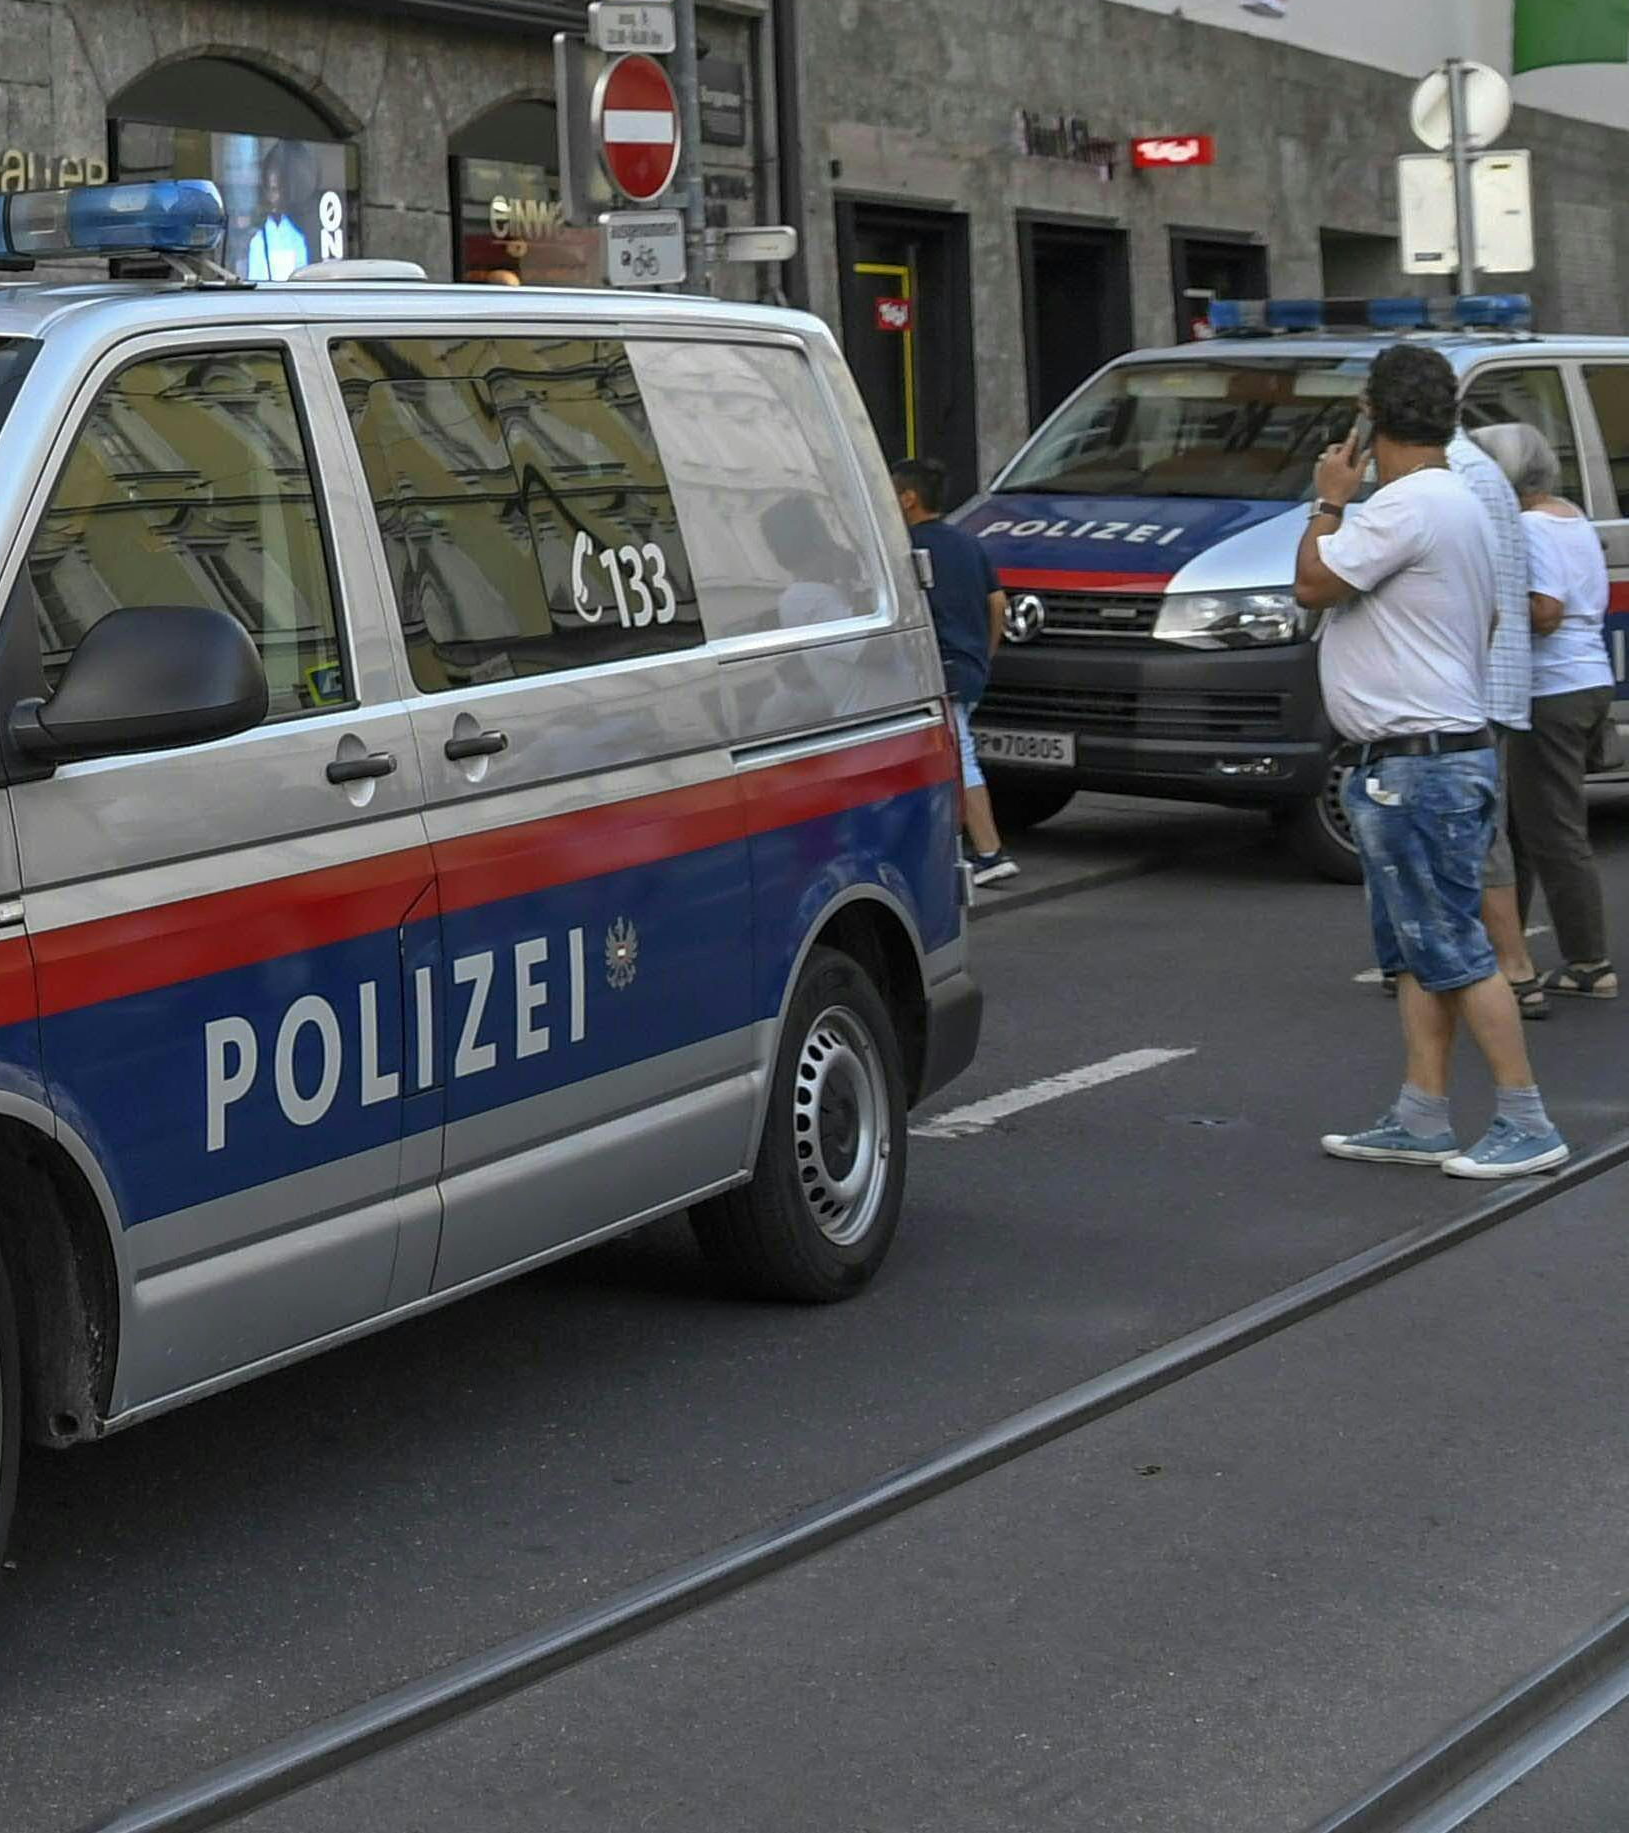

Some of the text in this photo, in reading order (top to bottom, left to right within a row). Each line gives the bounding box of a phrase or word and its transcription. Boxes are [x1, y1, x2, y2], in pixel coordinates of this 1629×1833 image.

[978, 519, 1185, 546] POLIZEI
[599, 539, 678, 630] 133
[1002, 734, 1064, 760] 70805
[204, 927, 590, 1154] POLIZEI
